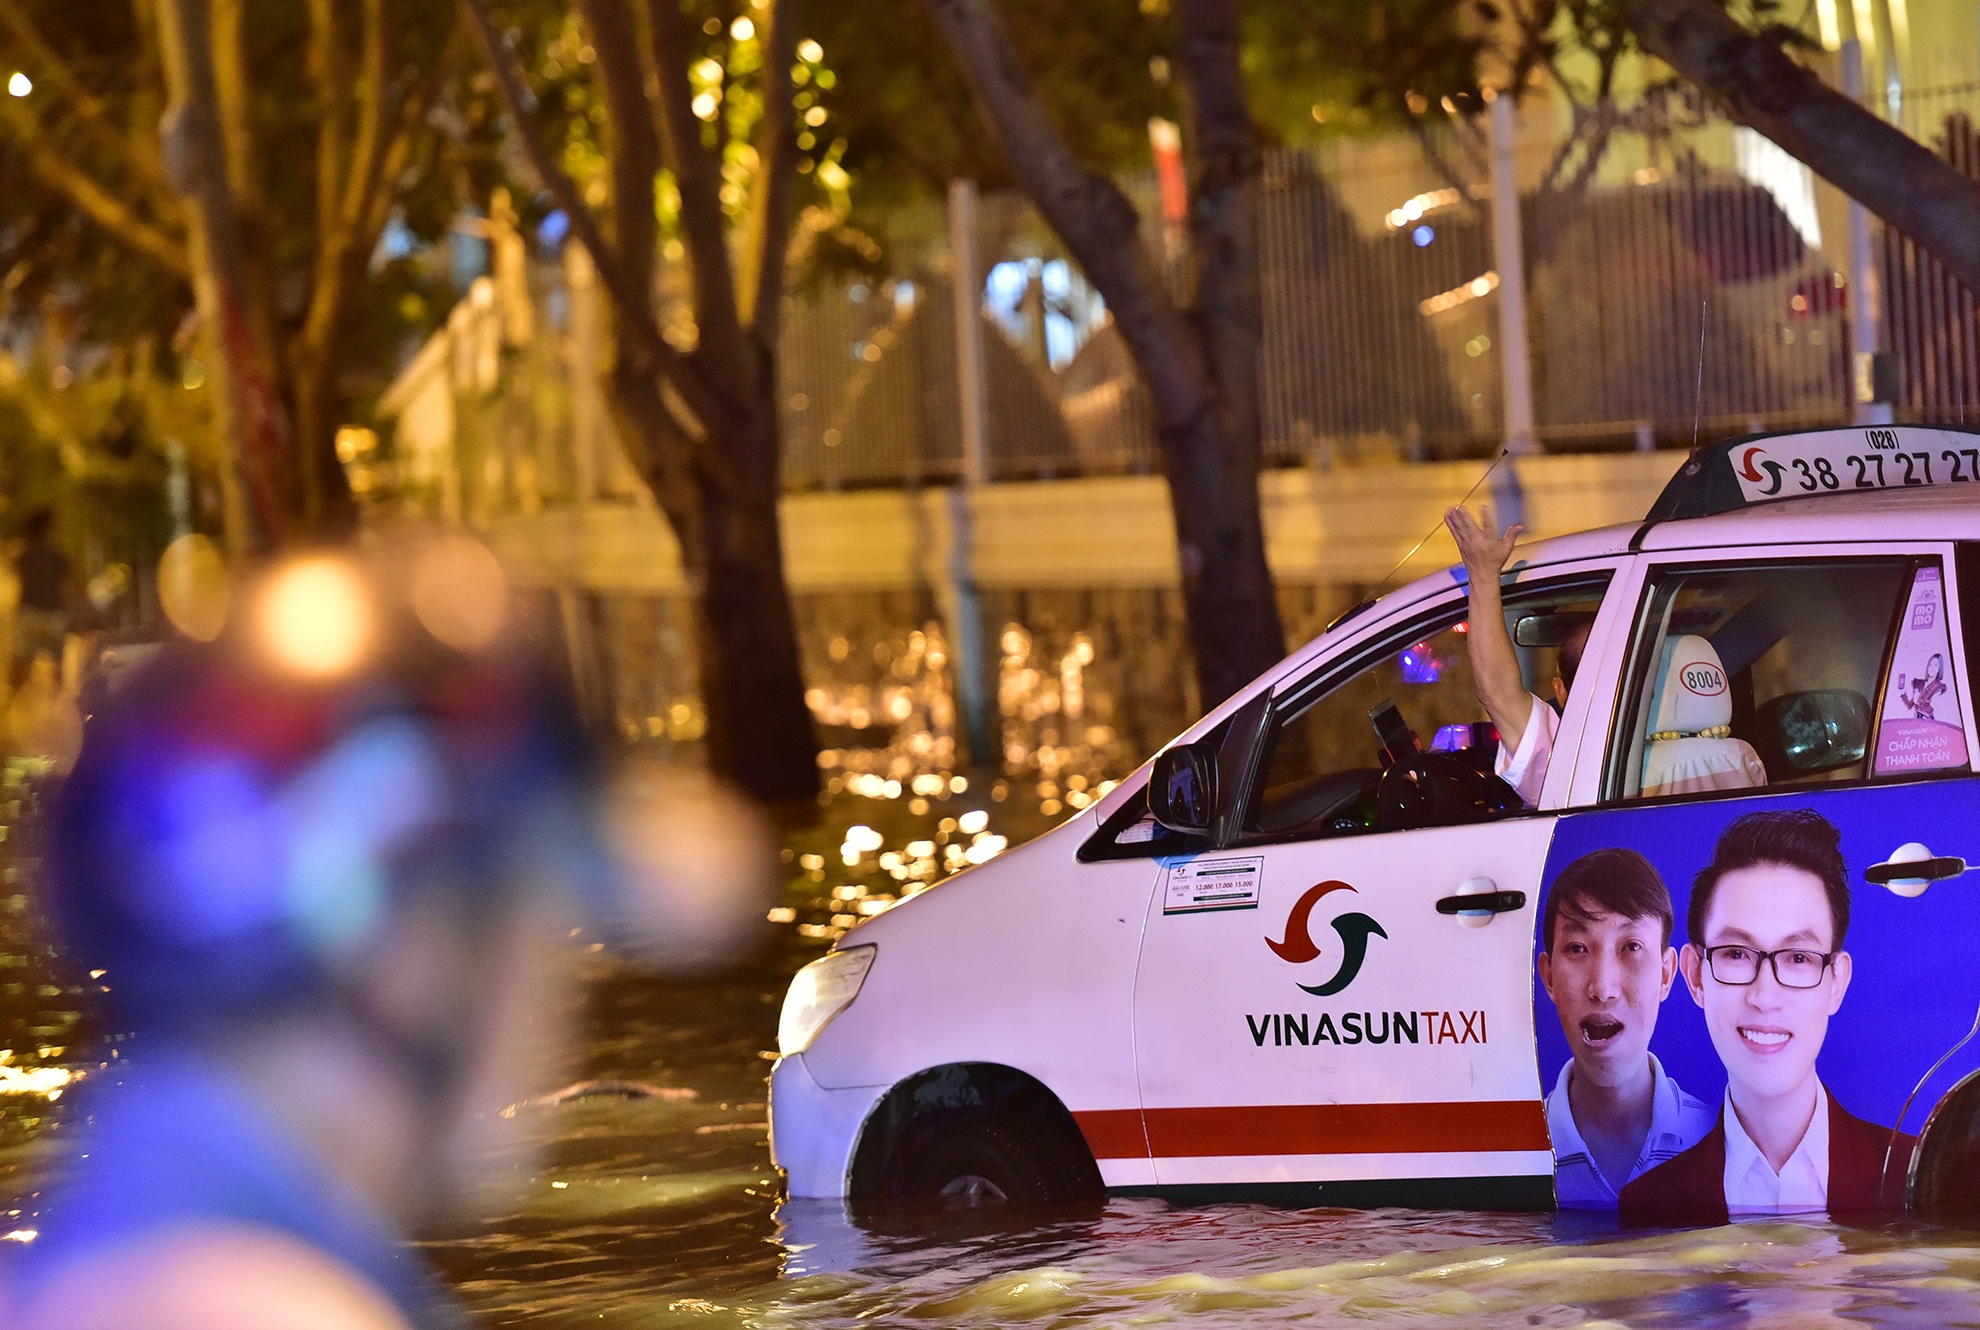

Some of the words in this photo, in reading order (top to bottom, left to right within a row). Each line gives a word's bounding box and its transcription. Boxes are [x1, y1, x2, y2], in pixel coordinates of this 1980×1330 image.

[1864, 429, 1900, 450] (028)
[1792, 457, 1840, 491] 38
[1846, 453, 1887, 489] 27
[1894, 451, 1934, 485] 27
[1941, 448, 1980, 482] 27
[1686, 670, 1723, 689] 8004
[1884, 753, 1920, 767] THANH
[1922, 749, 1951, 763] TOÁN
[1195, 883, 1214, 891] 12.000
